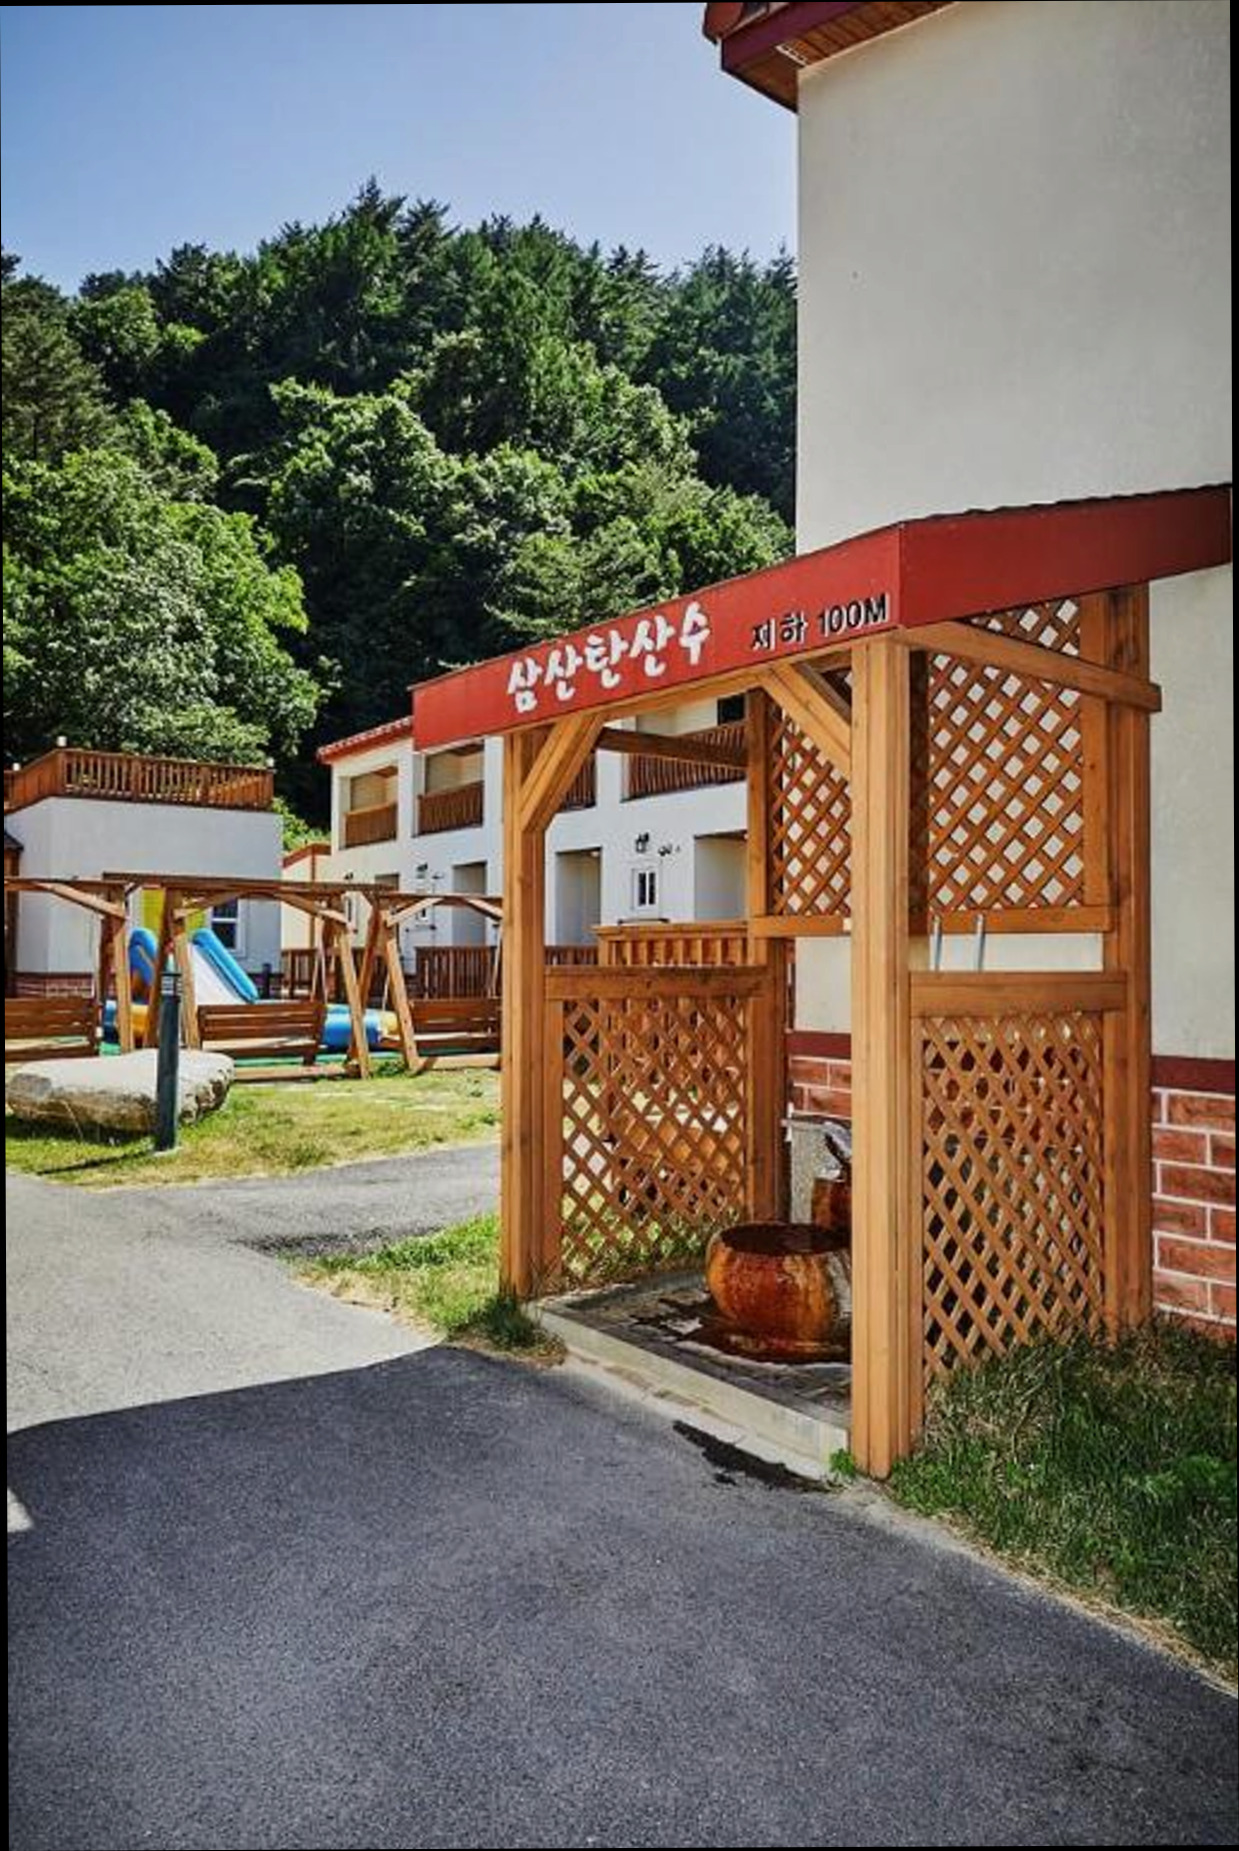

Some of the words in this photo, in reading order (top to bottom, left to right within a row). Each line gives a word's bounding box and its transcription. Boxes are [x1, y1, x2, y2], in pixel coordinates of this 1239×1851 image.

[508, 601, 710, 713] 삼산탄산수
[752, 612, 807, 651] 지하
[818, 593, 890, 637] 100M
